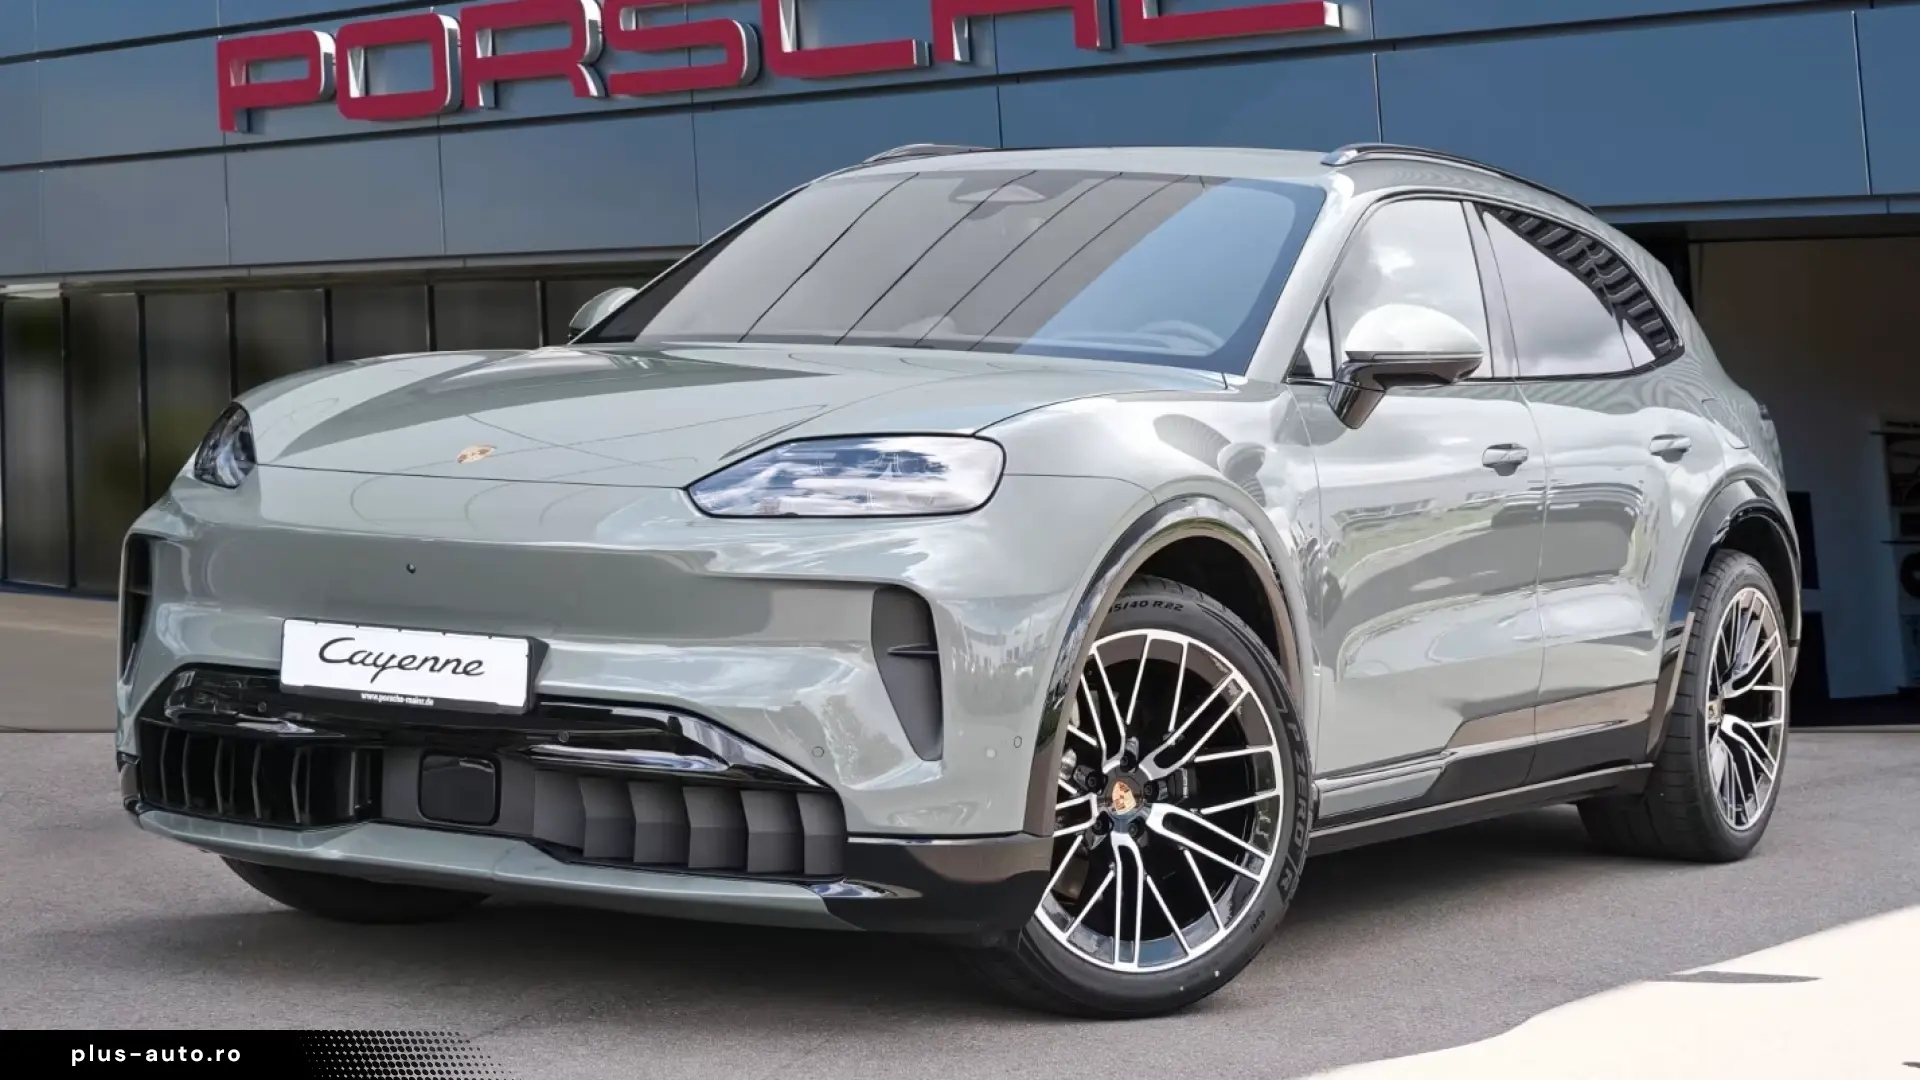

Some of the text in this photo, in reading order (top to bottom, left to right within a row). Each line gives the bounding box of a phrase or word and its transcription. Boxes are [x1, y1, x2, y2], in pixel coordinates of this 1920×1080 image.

[1152, 600, 1184, 612] R22
[318, 636, 486, 684] Cayenne
[1294, 748, 1308, 847] ZERO
